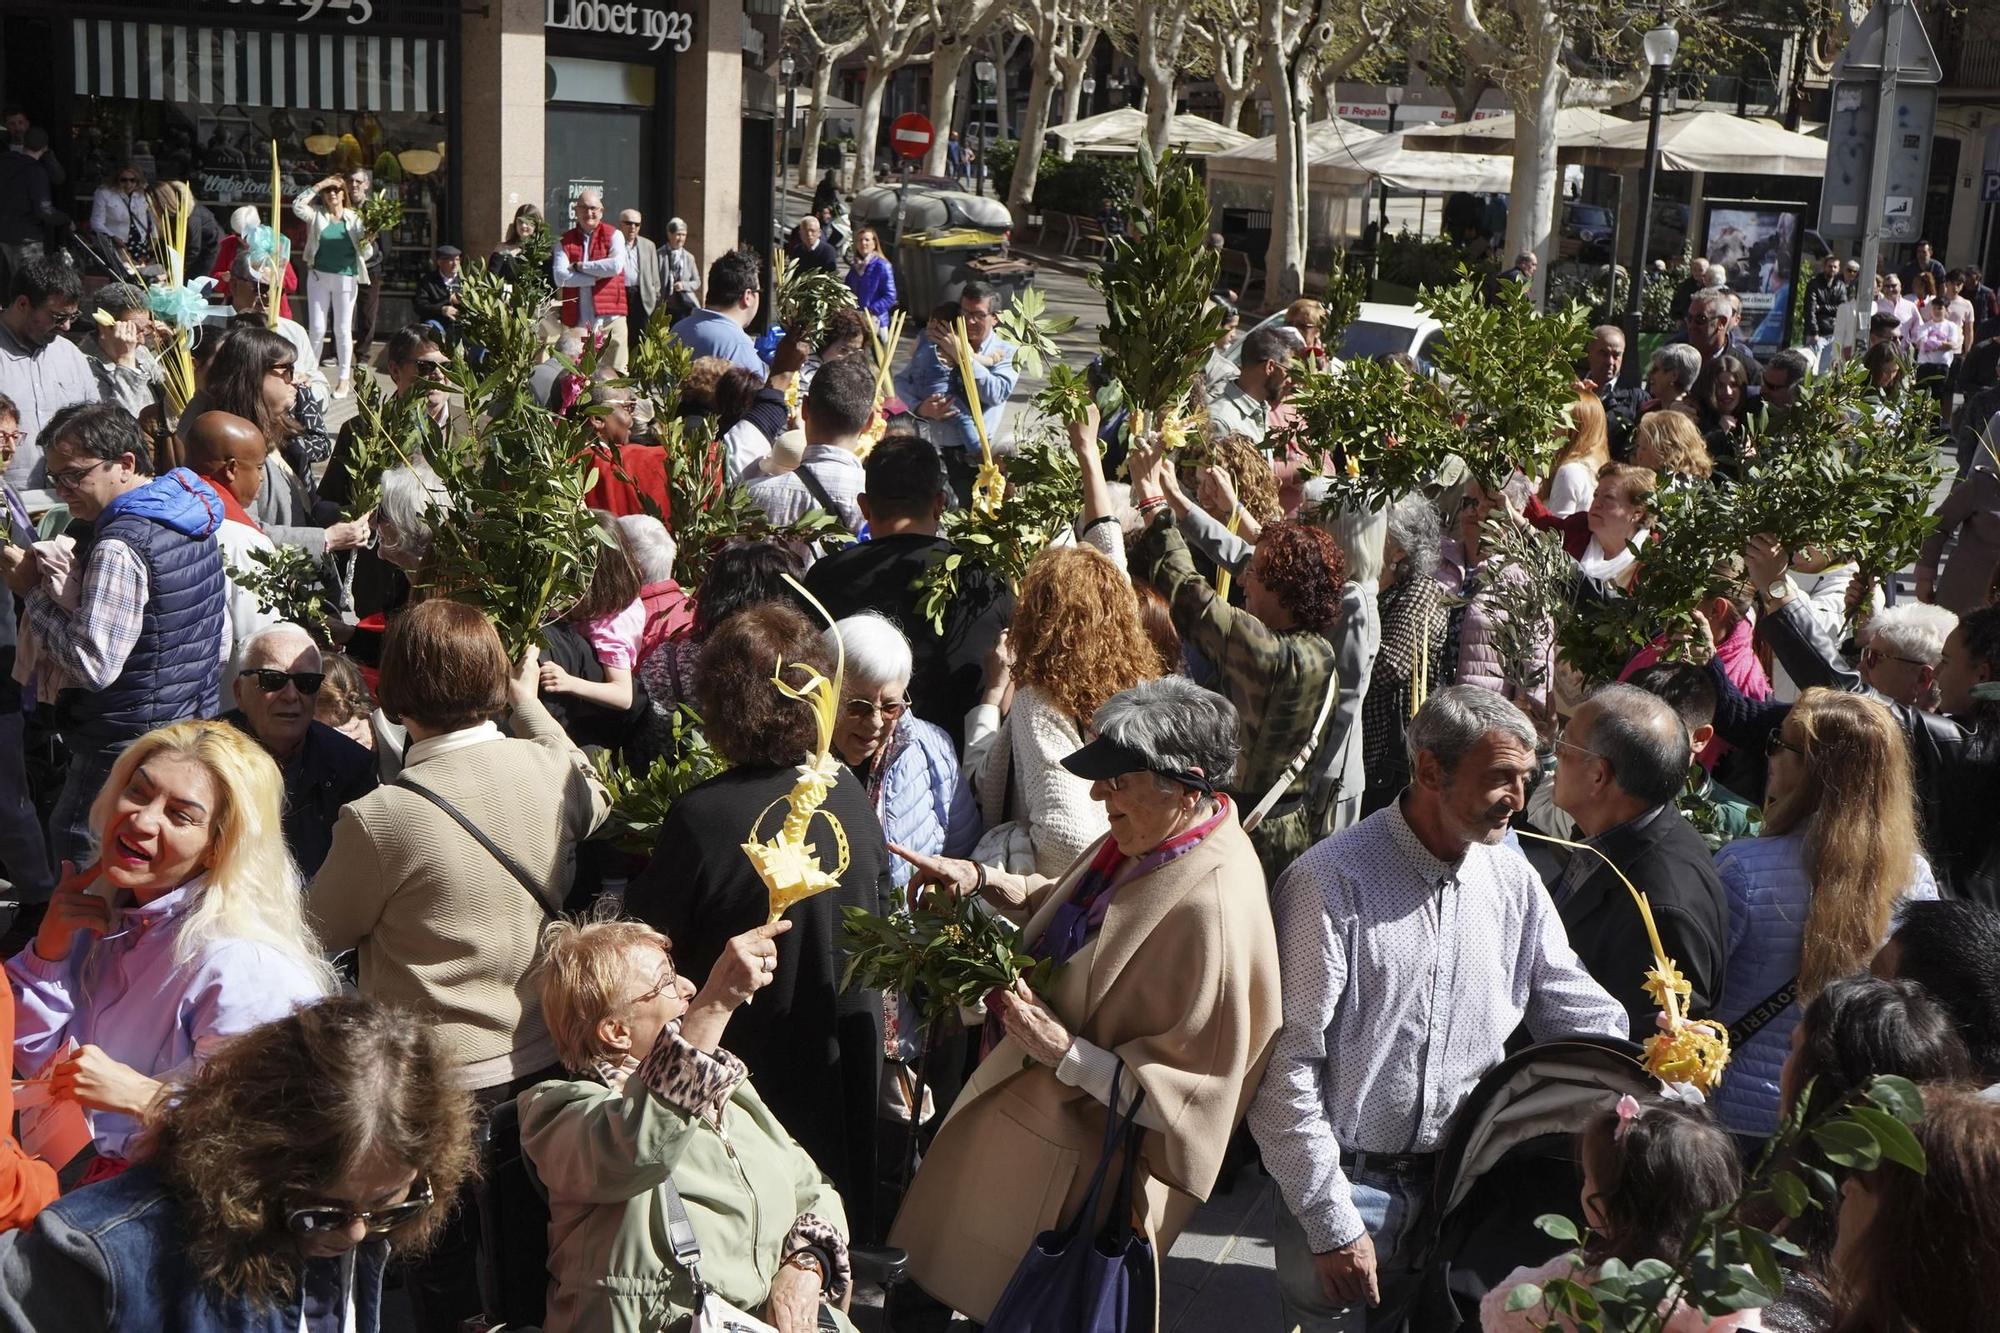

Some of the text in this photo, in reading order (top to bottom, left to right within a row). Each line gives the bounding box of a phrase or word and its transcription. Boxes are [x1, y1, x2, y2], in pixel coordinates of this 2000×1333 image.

[544, 0, 693, 52] Llobet 1923
[1338, 106, 1387, 117] El Regalo
